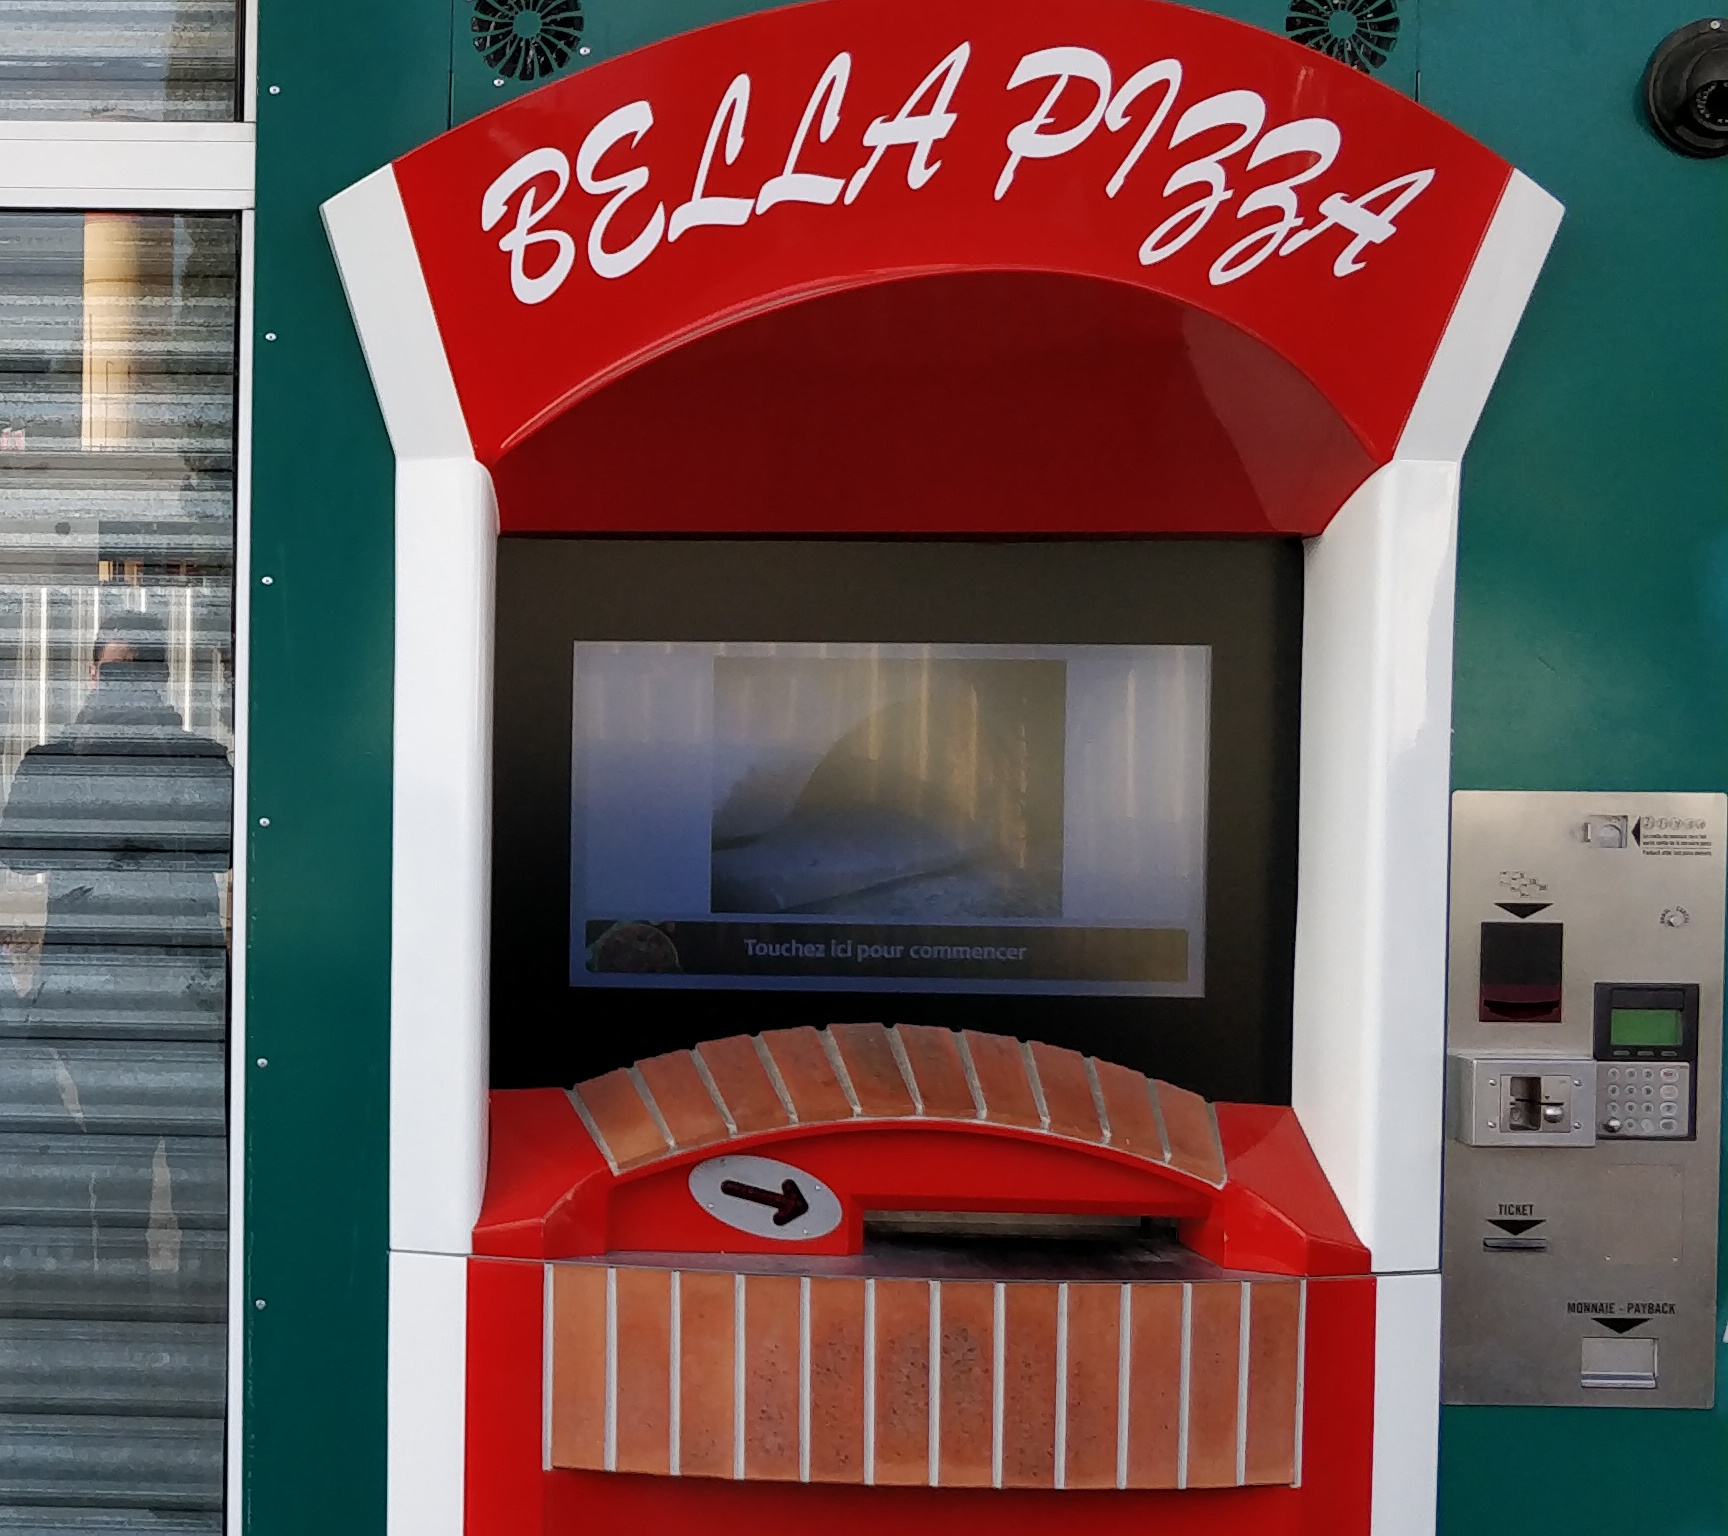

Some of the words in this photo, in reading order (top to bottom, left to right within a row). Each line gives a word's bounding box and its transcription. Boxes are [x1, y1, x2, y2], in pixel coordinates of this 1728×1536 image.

[481, 41, 970, 304] BELLA
[994, 47, 1436, 285] PIZZA
[743, 938, 826, 957] Touchez
[830, 938, 853, 957] ici
[856, 943, 905, 962] pour
[908, 943, 1028, 961] commencer
[1497, 1203, 1535, 1216] TICKET
[1567, 1302, 1616, 1314] MONNAIE
[1626, 1302, 1676, 1315] PAYBACK
